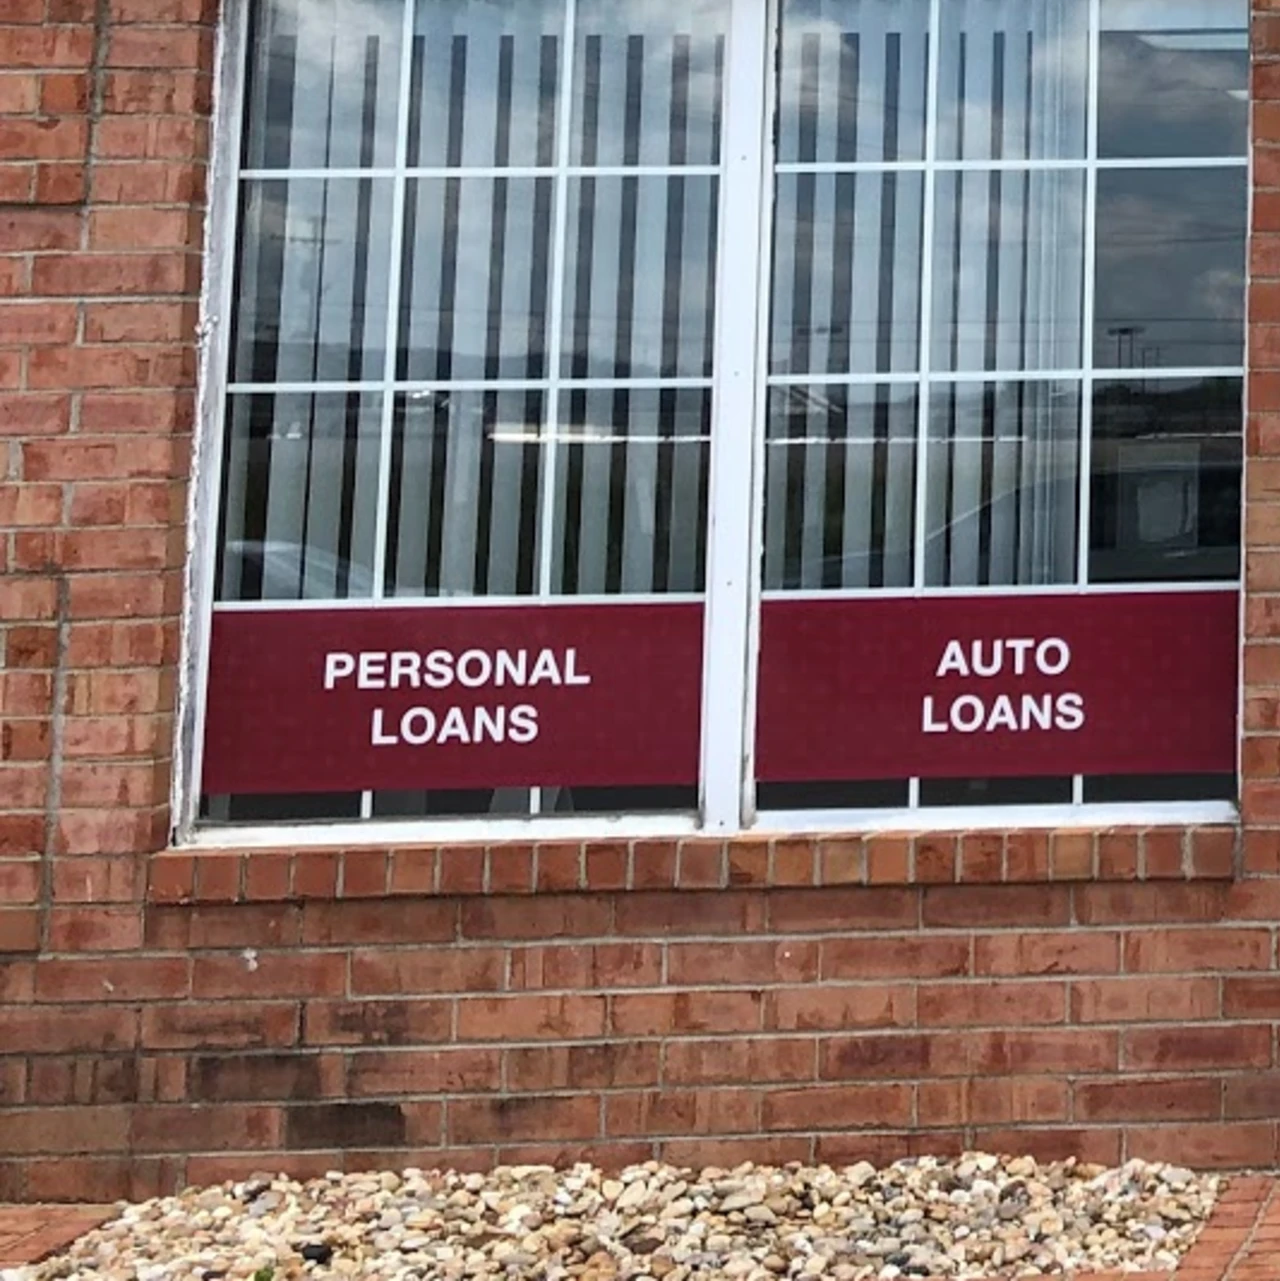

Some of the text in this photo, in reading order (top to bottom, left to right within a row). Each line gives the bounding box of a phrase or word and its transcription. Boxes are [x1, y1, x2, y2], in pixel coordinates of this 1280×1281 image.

[323, 647, 591, 691] PERSONAL
[936, 637, 1072, 678] AUTO
[370, 704, 540, 745] LOANS
[921, 694, 1086, 734] LOANS
